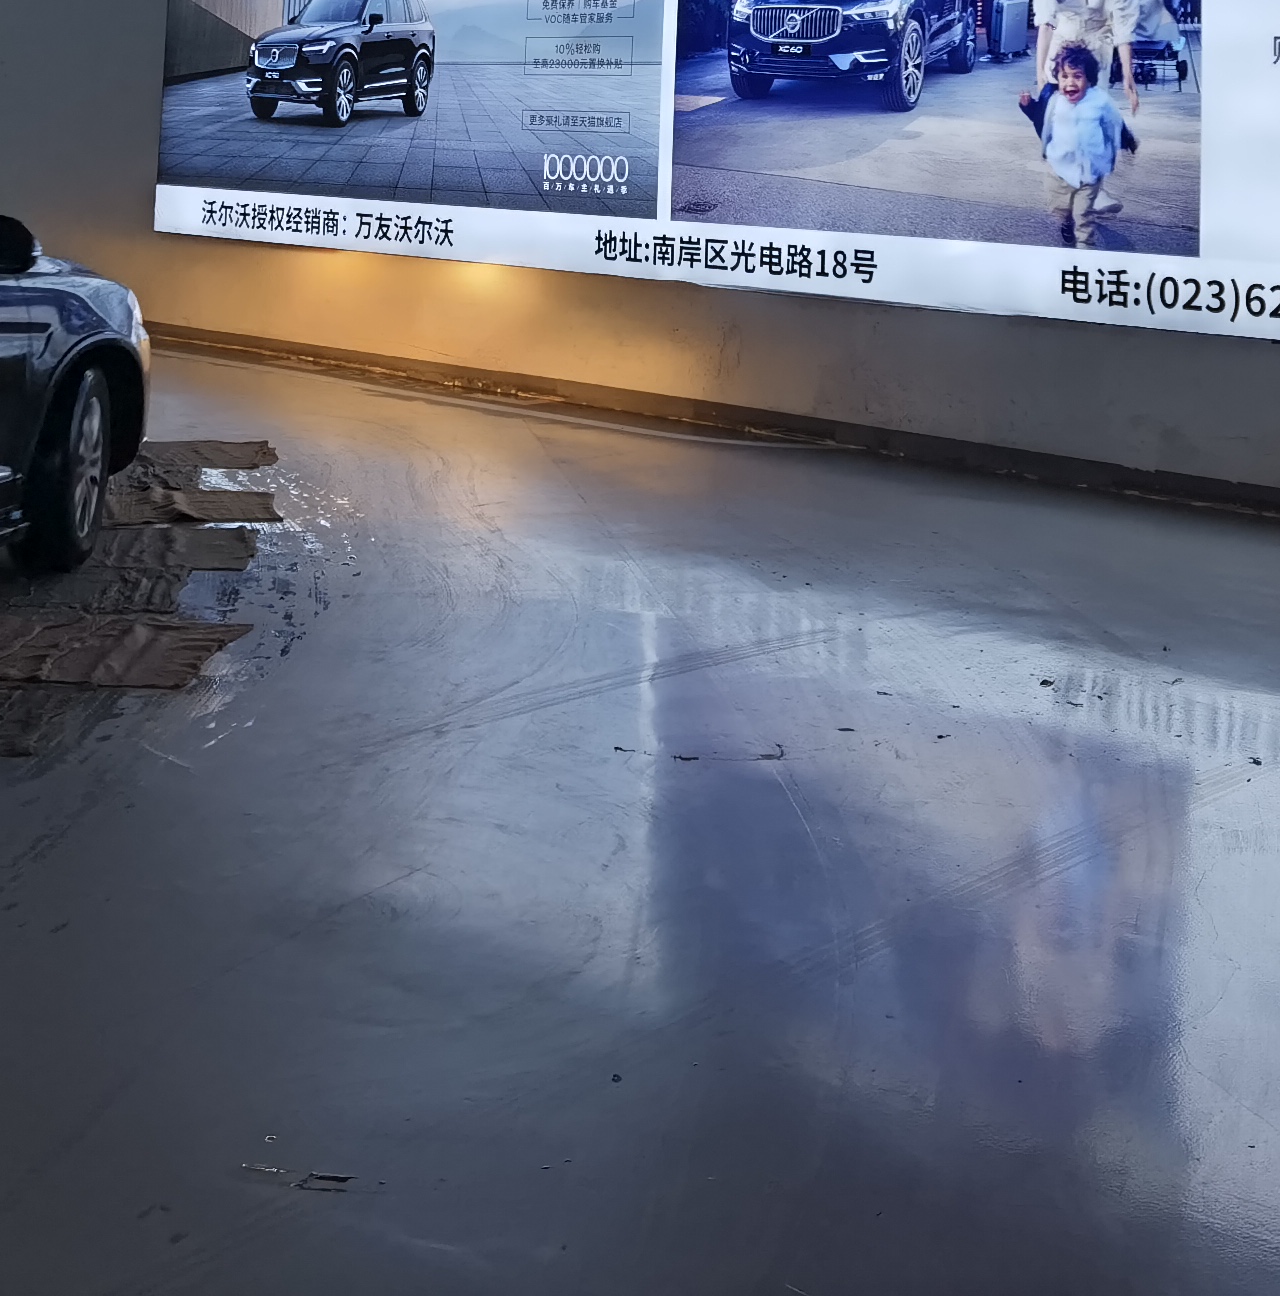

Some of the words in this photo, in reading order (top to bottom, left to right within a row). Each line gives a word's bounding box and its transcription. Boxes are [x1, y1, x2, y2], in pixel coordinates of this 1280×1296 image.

[554, 43, 601, 55] 10%轻松购
[543, 153, 629, 183] 1000000
